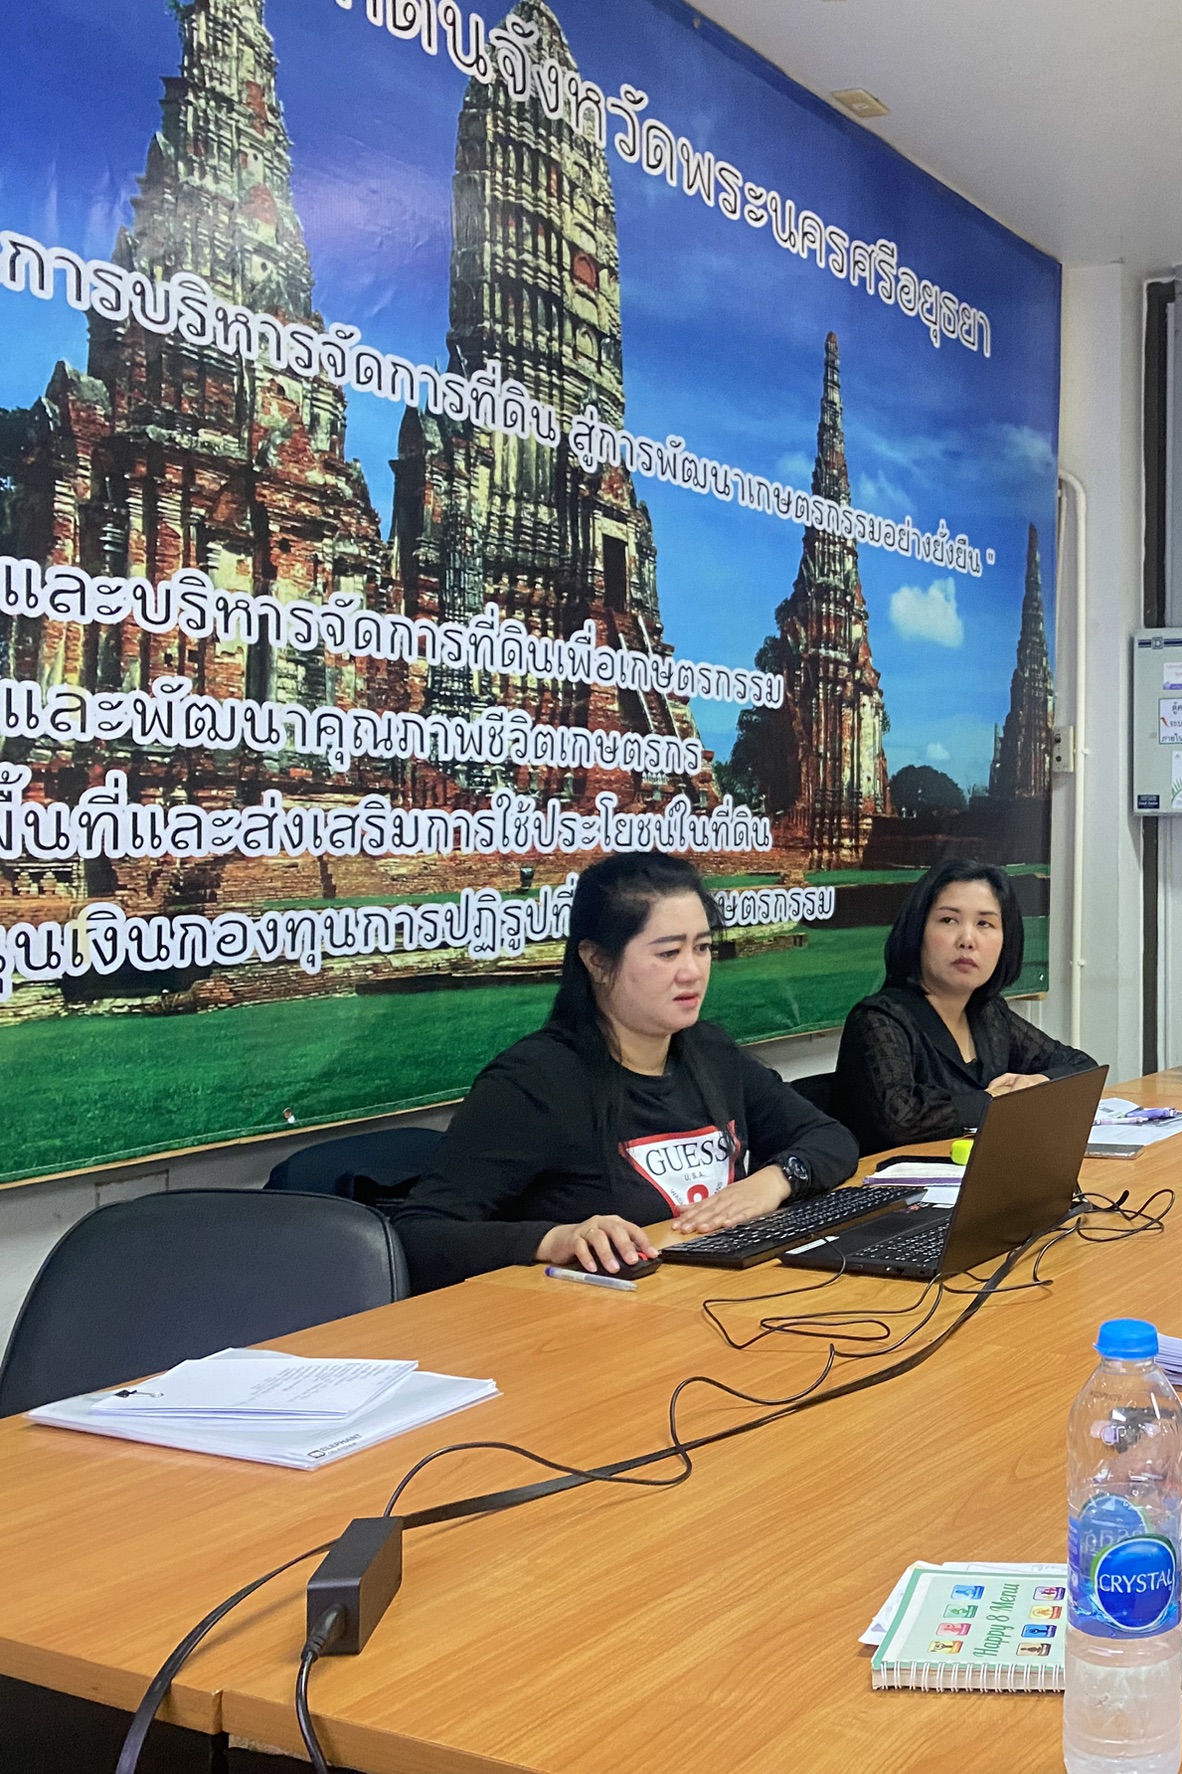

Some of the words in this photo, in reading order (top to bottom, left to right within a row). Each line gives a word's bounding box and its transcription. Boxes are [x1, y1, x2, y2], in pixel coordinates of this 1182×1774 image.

[7, 236, 556, 443] การบริหารจัดการที่ดิน
[2, 562, 783, 706] และบริหารจัดการที่ดินเพื่อเกษตรกรรม
[3, 682, 701, 772] และพัฒนาคุณภาพชีวิตเกษตรกร
[645, 1135, 729, 1176] GUESS
[989, 1583, 1021, 1612] Menu
[1099, 1568, 1173, 1594] CRYSTAL
[985, 1613, 1010, 1623] 8
[972, 1624, 1015, 1658] Happy
